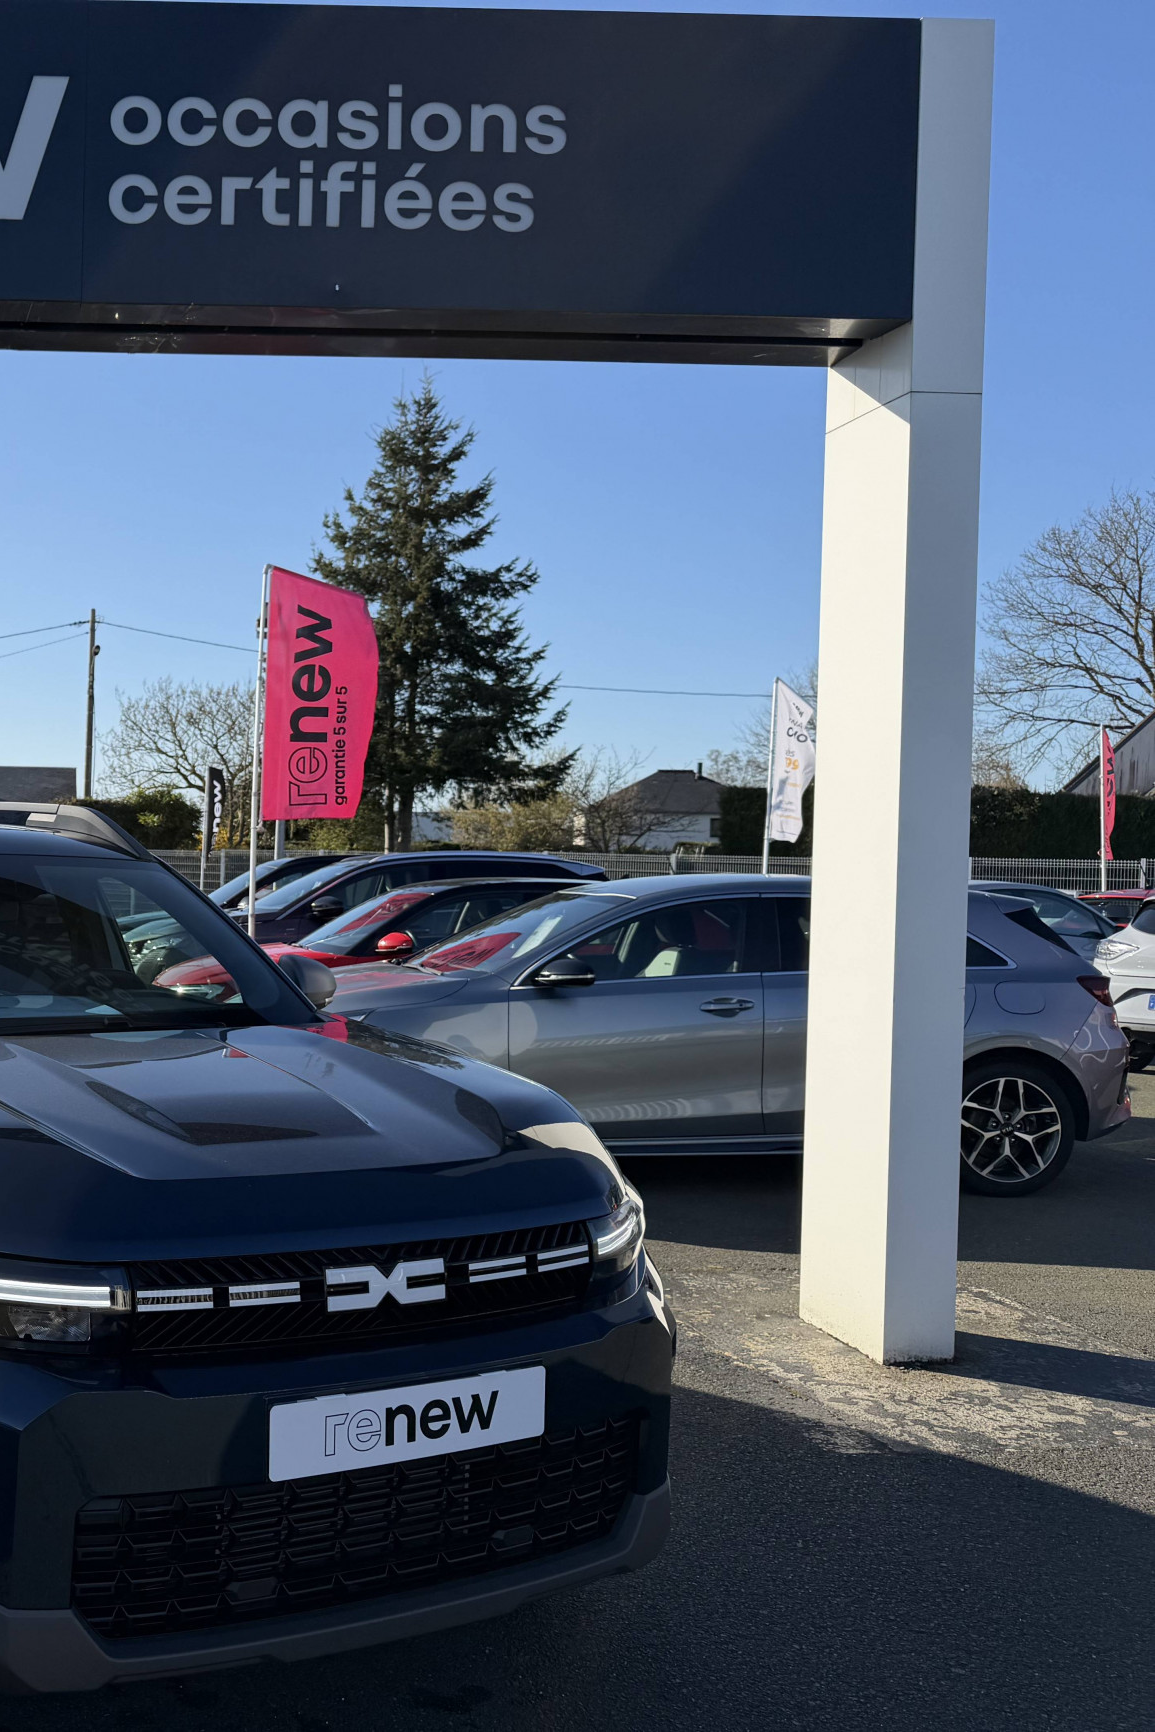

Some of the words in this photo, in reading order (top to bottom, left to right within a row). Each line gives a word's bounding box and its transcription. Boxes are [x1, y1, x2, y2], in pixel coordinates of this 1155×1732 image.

[110, 84, 567, 155] occasions
[108, 160, 535, 232] certifiées
[288, 604, 333, 808] renew
[335, 686, 348, 695] 5
[336, 698, 348, 724] sur
[333, 726, 346, 736] 5
[332, 739, 348, 806] garantie
[324, 1390, 499, 1457] renew
